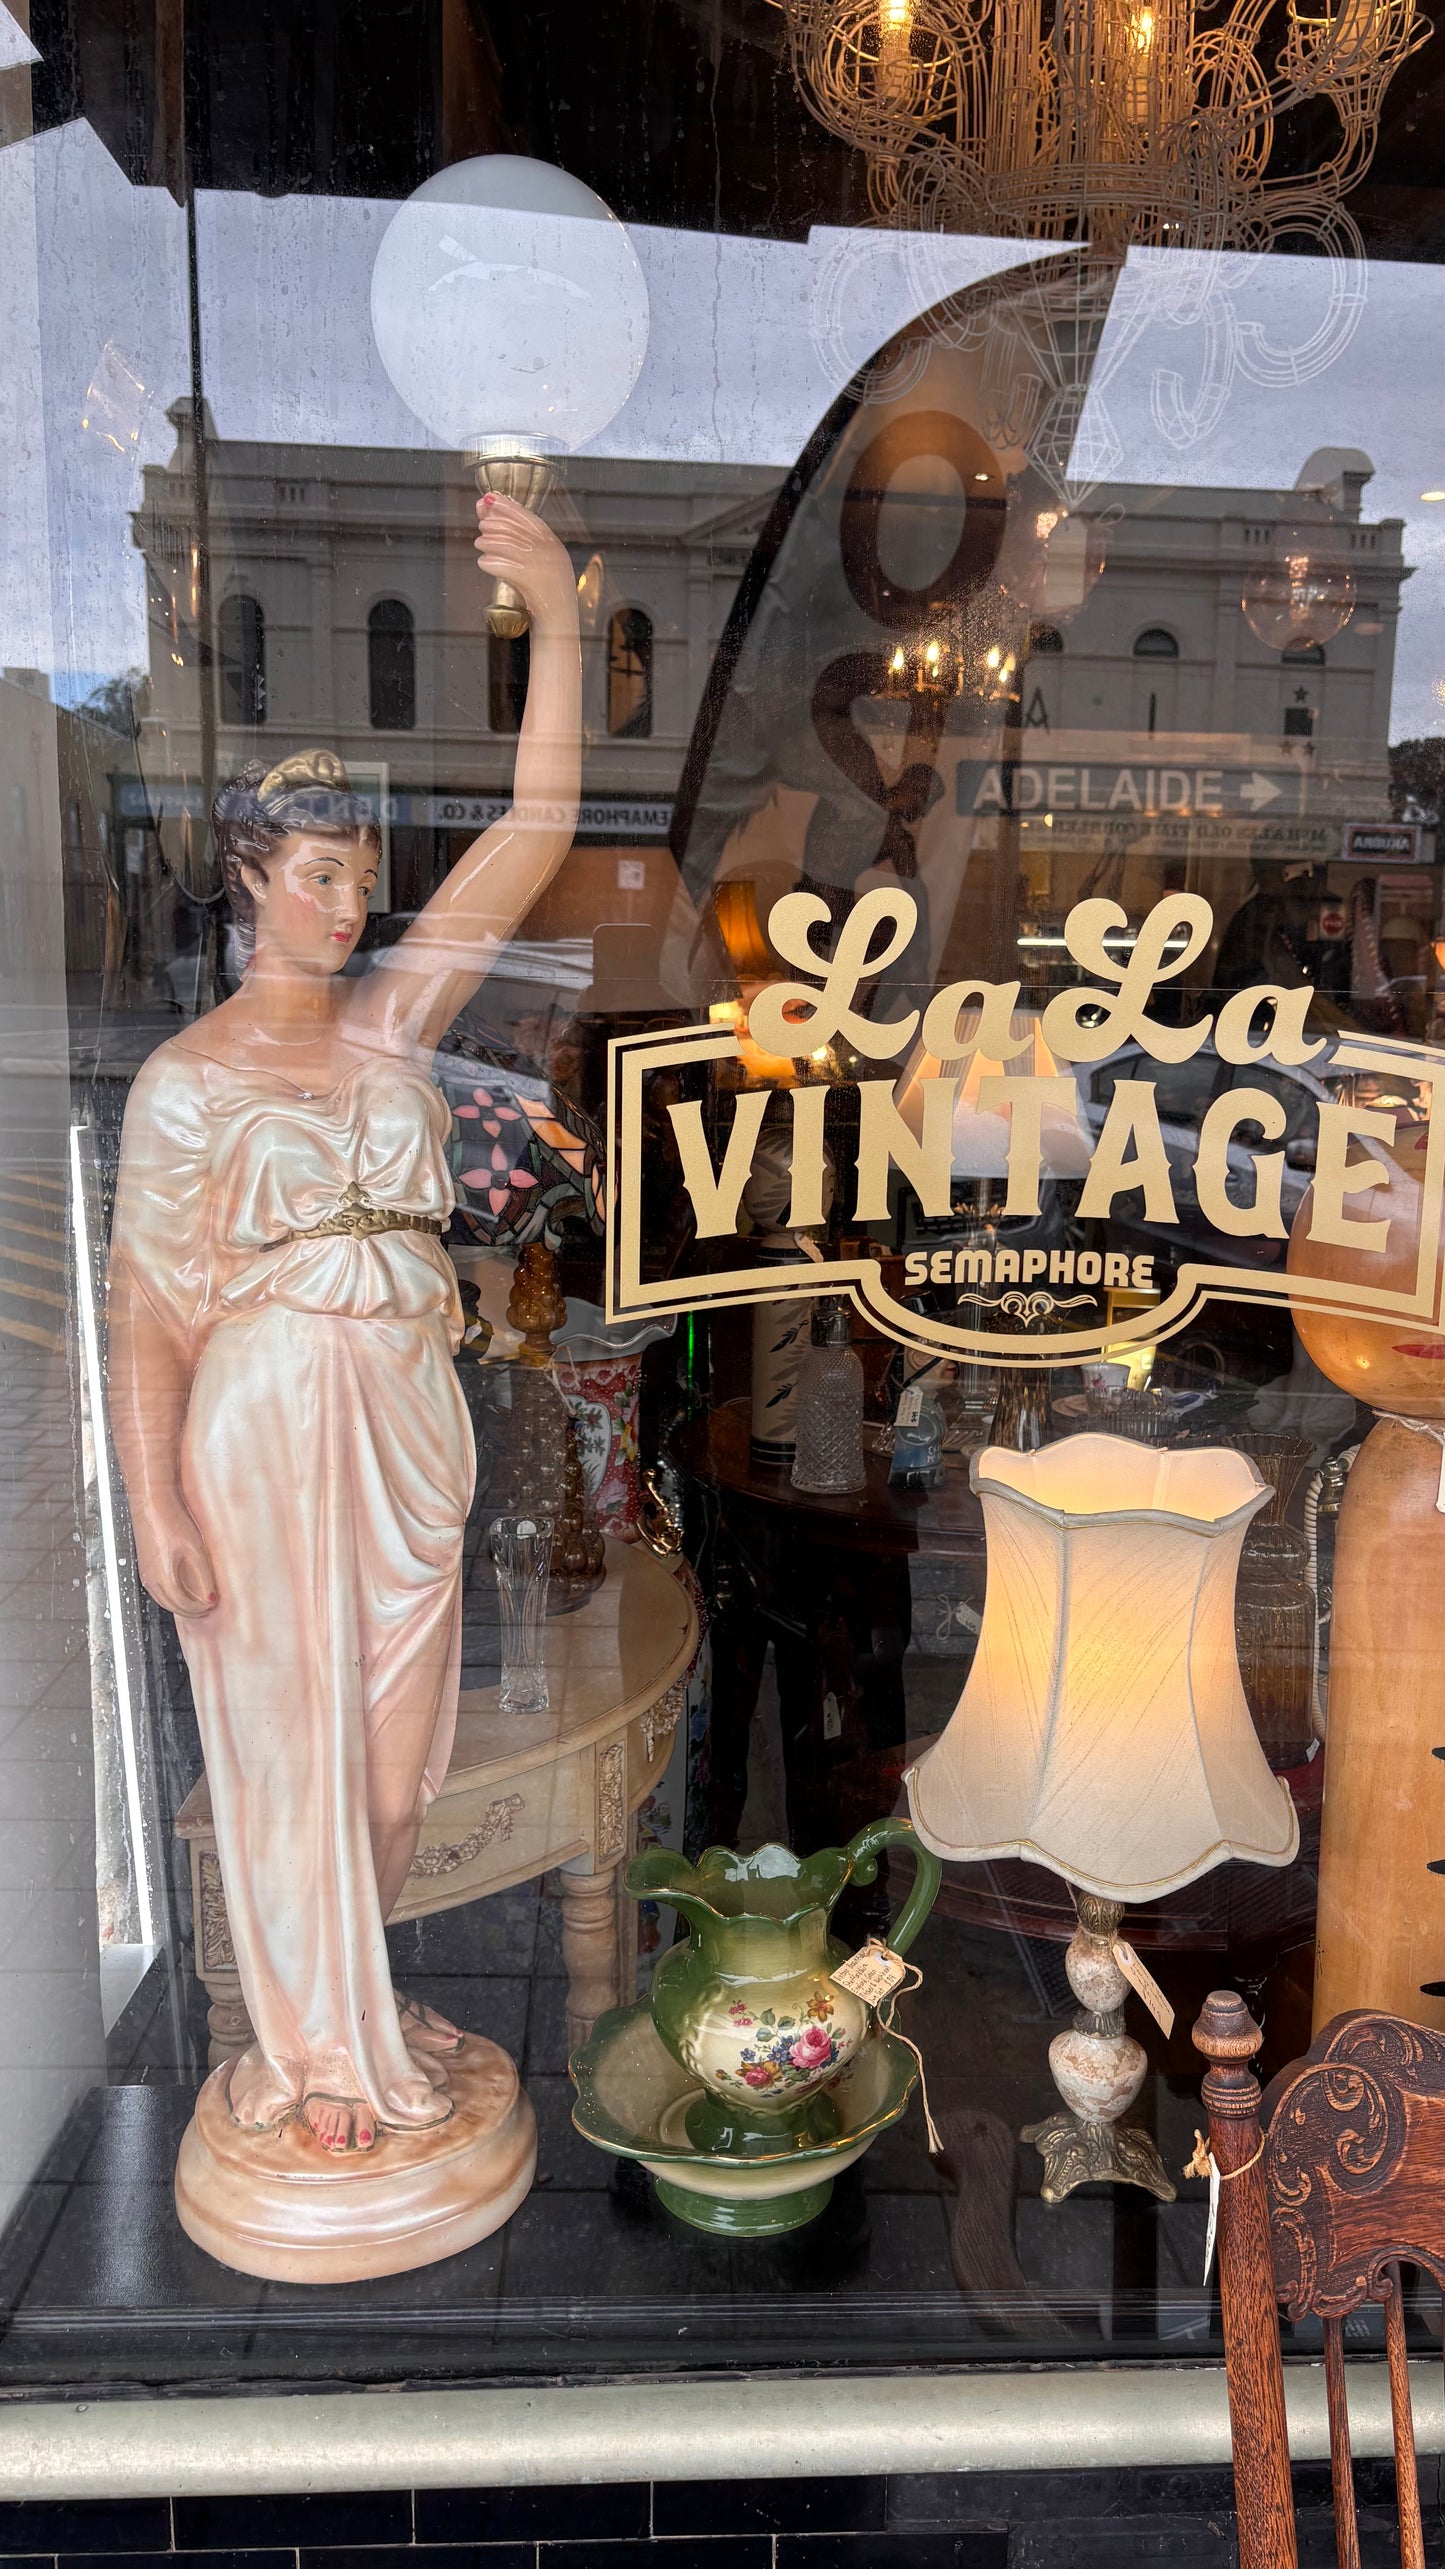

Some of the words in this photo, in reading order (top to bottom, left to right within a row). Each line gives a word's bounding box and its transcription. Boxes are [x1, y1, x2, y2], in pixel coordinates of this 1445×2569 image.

[972, 766, 1223, 811] ADELAIDE
[666, 1075, 1400, 1254] VINTAGE
[904, 1249, 1155, 1288] SEMAPHORE
